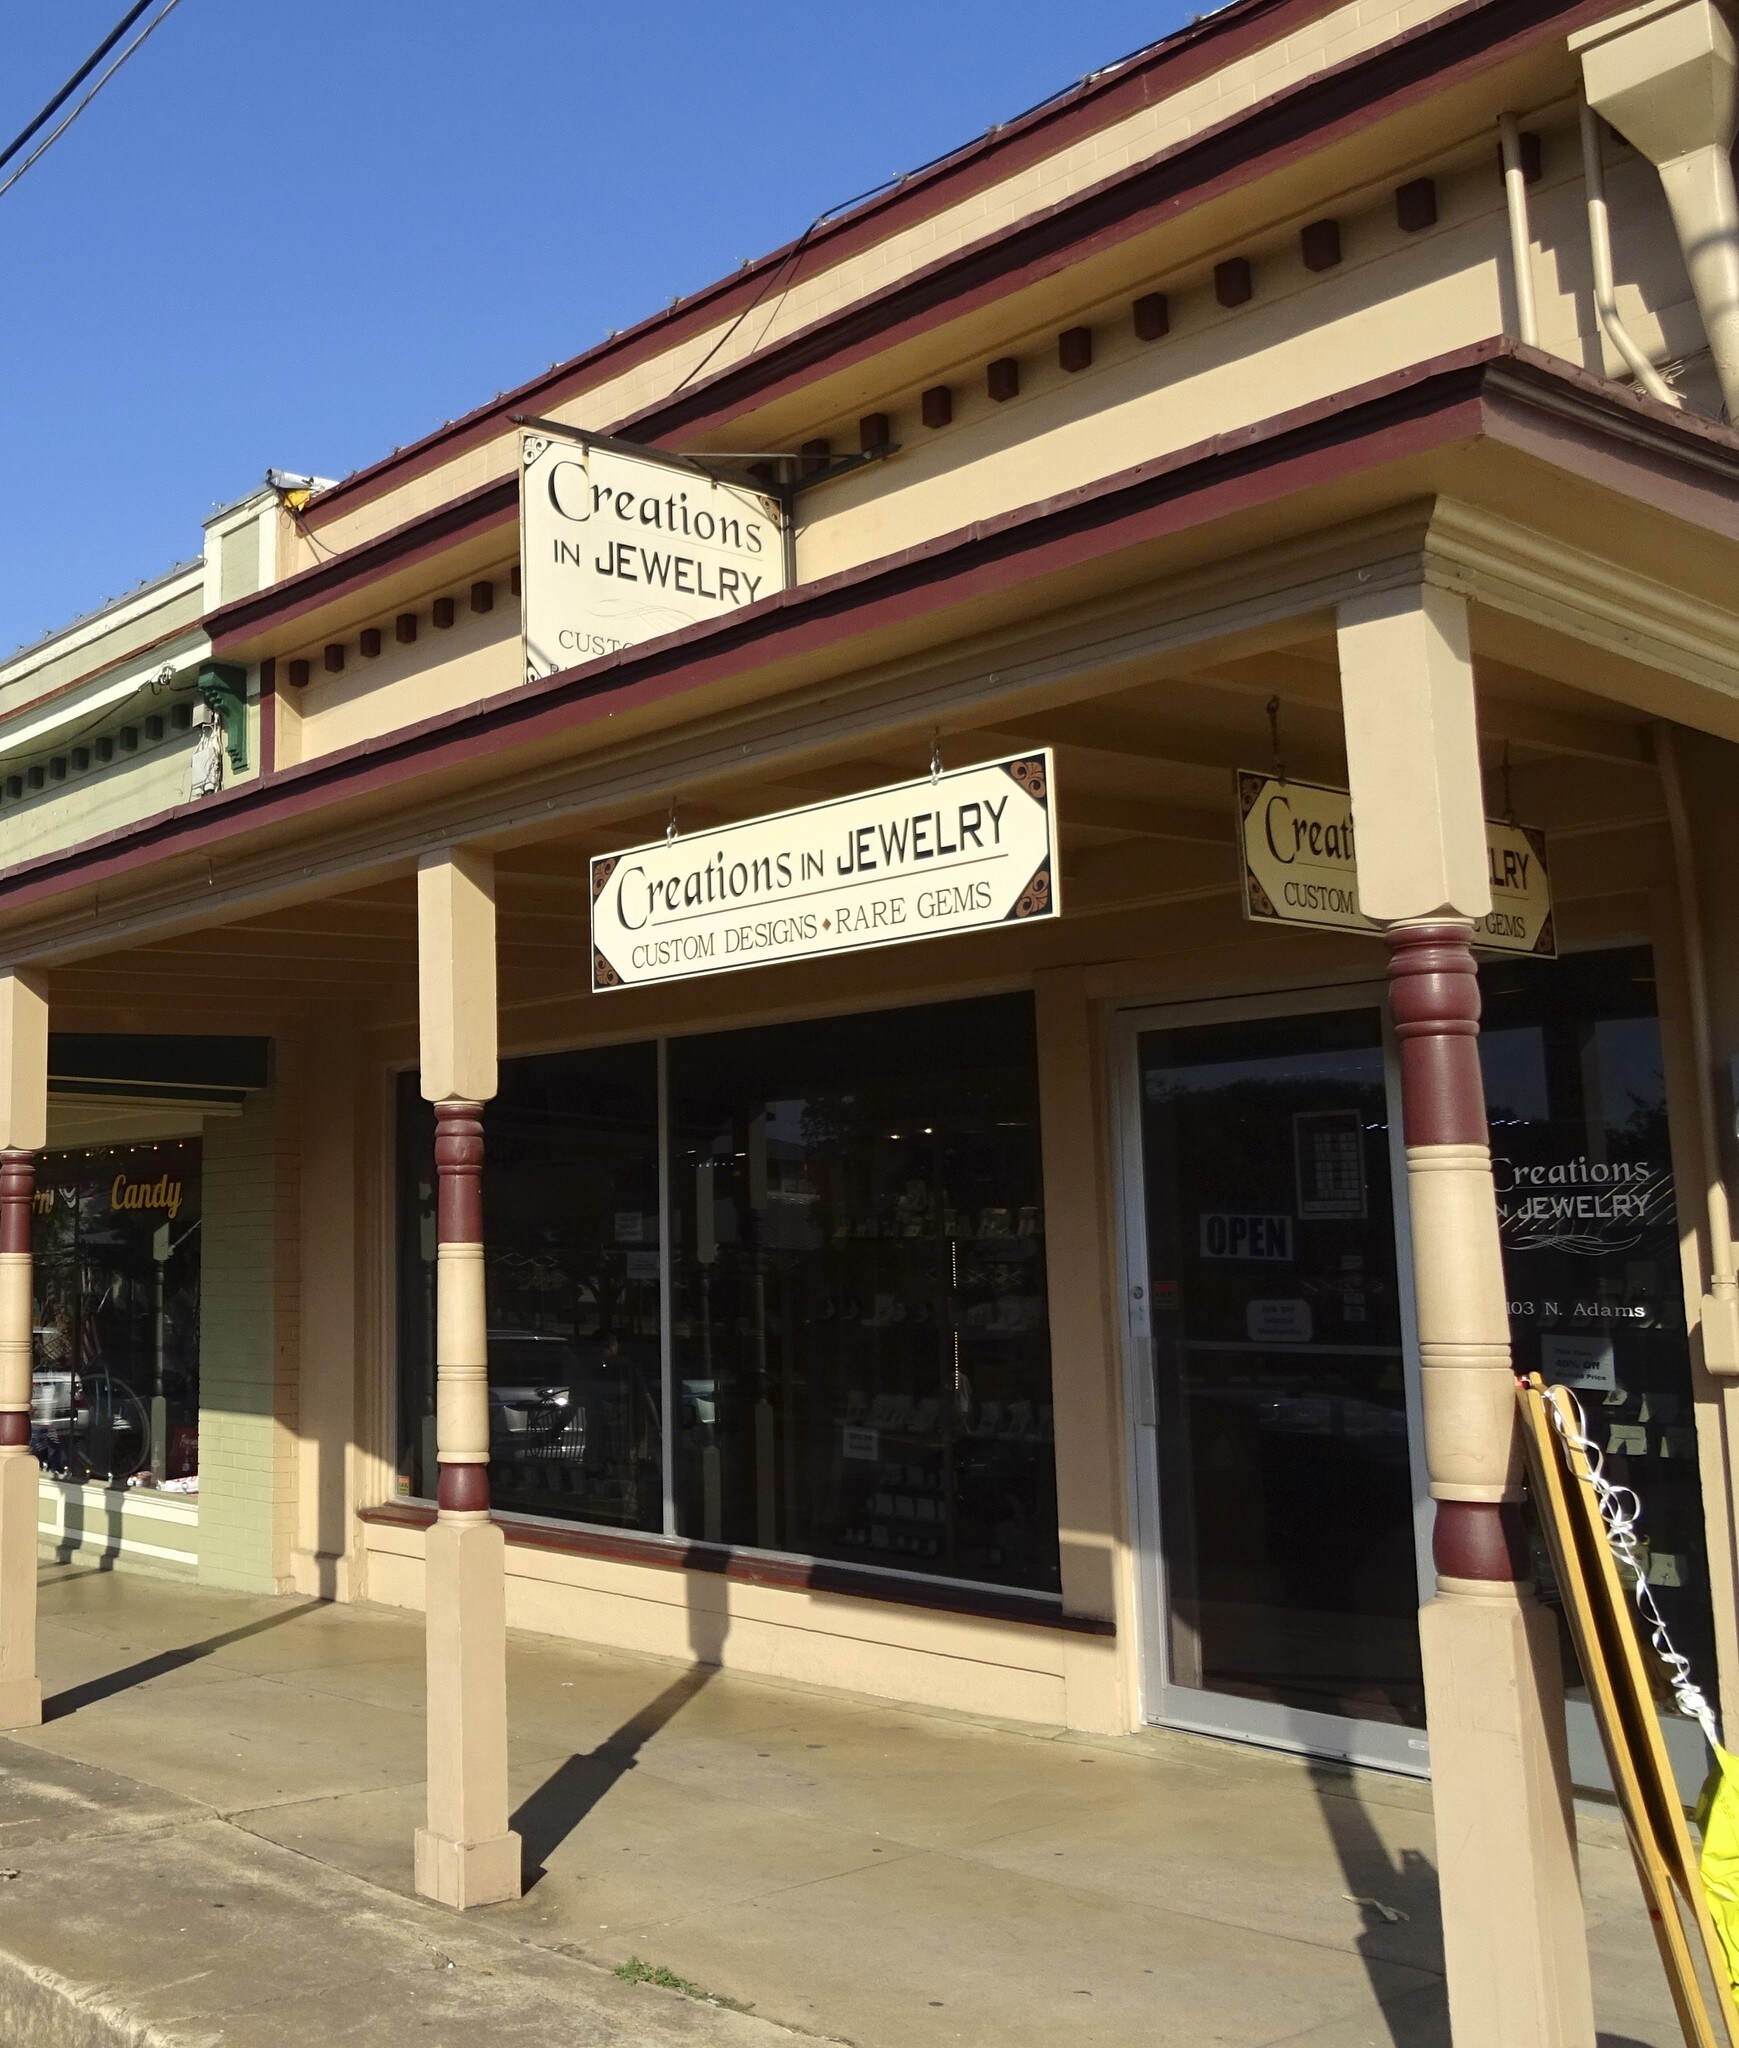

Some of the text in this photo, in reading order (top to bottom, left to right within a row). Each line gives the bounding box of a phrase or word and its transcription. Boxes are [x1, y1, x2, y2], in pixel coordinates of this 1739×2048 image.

[548, 460, 763, 553] Creations
[553, 539, 763, 605] IN JEWELRY
[558, 629, 634, 656] CUST
[616, 795, 1009, 931] Creations IN JEWELRY
[631, 881, 992, 969] CUSTOM DESIGNS RARE GEMS
[1284, 881, 1355, 914] CUSTOM
[1485, 912, 1526, 939] GEMS
[111, 1173, 183, 1219] Candy
[1517, 1195, 1650, 1219] JEWELRY
[1206, 1215, 1287, 1257] OPEN
[1545, 1302, 1563, 1316] N.
[1573, 1303, 1646, 1318] Adams
